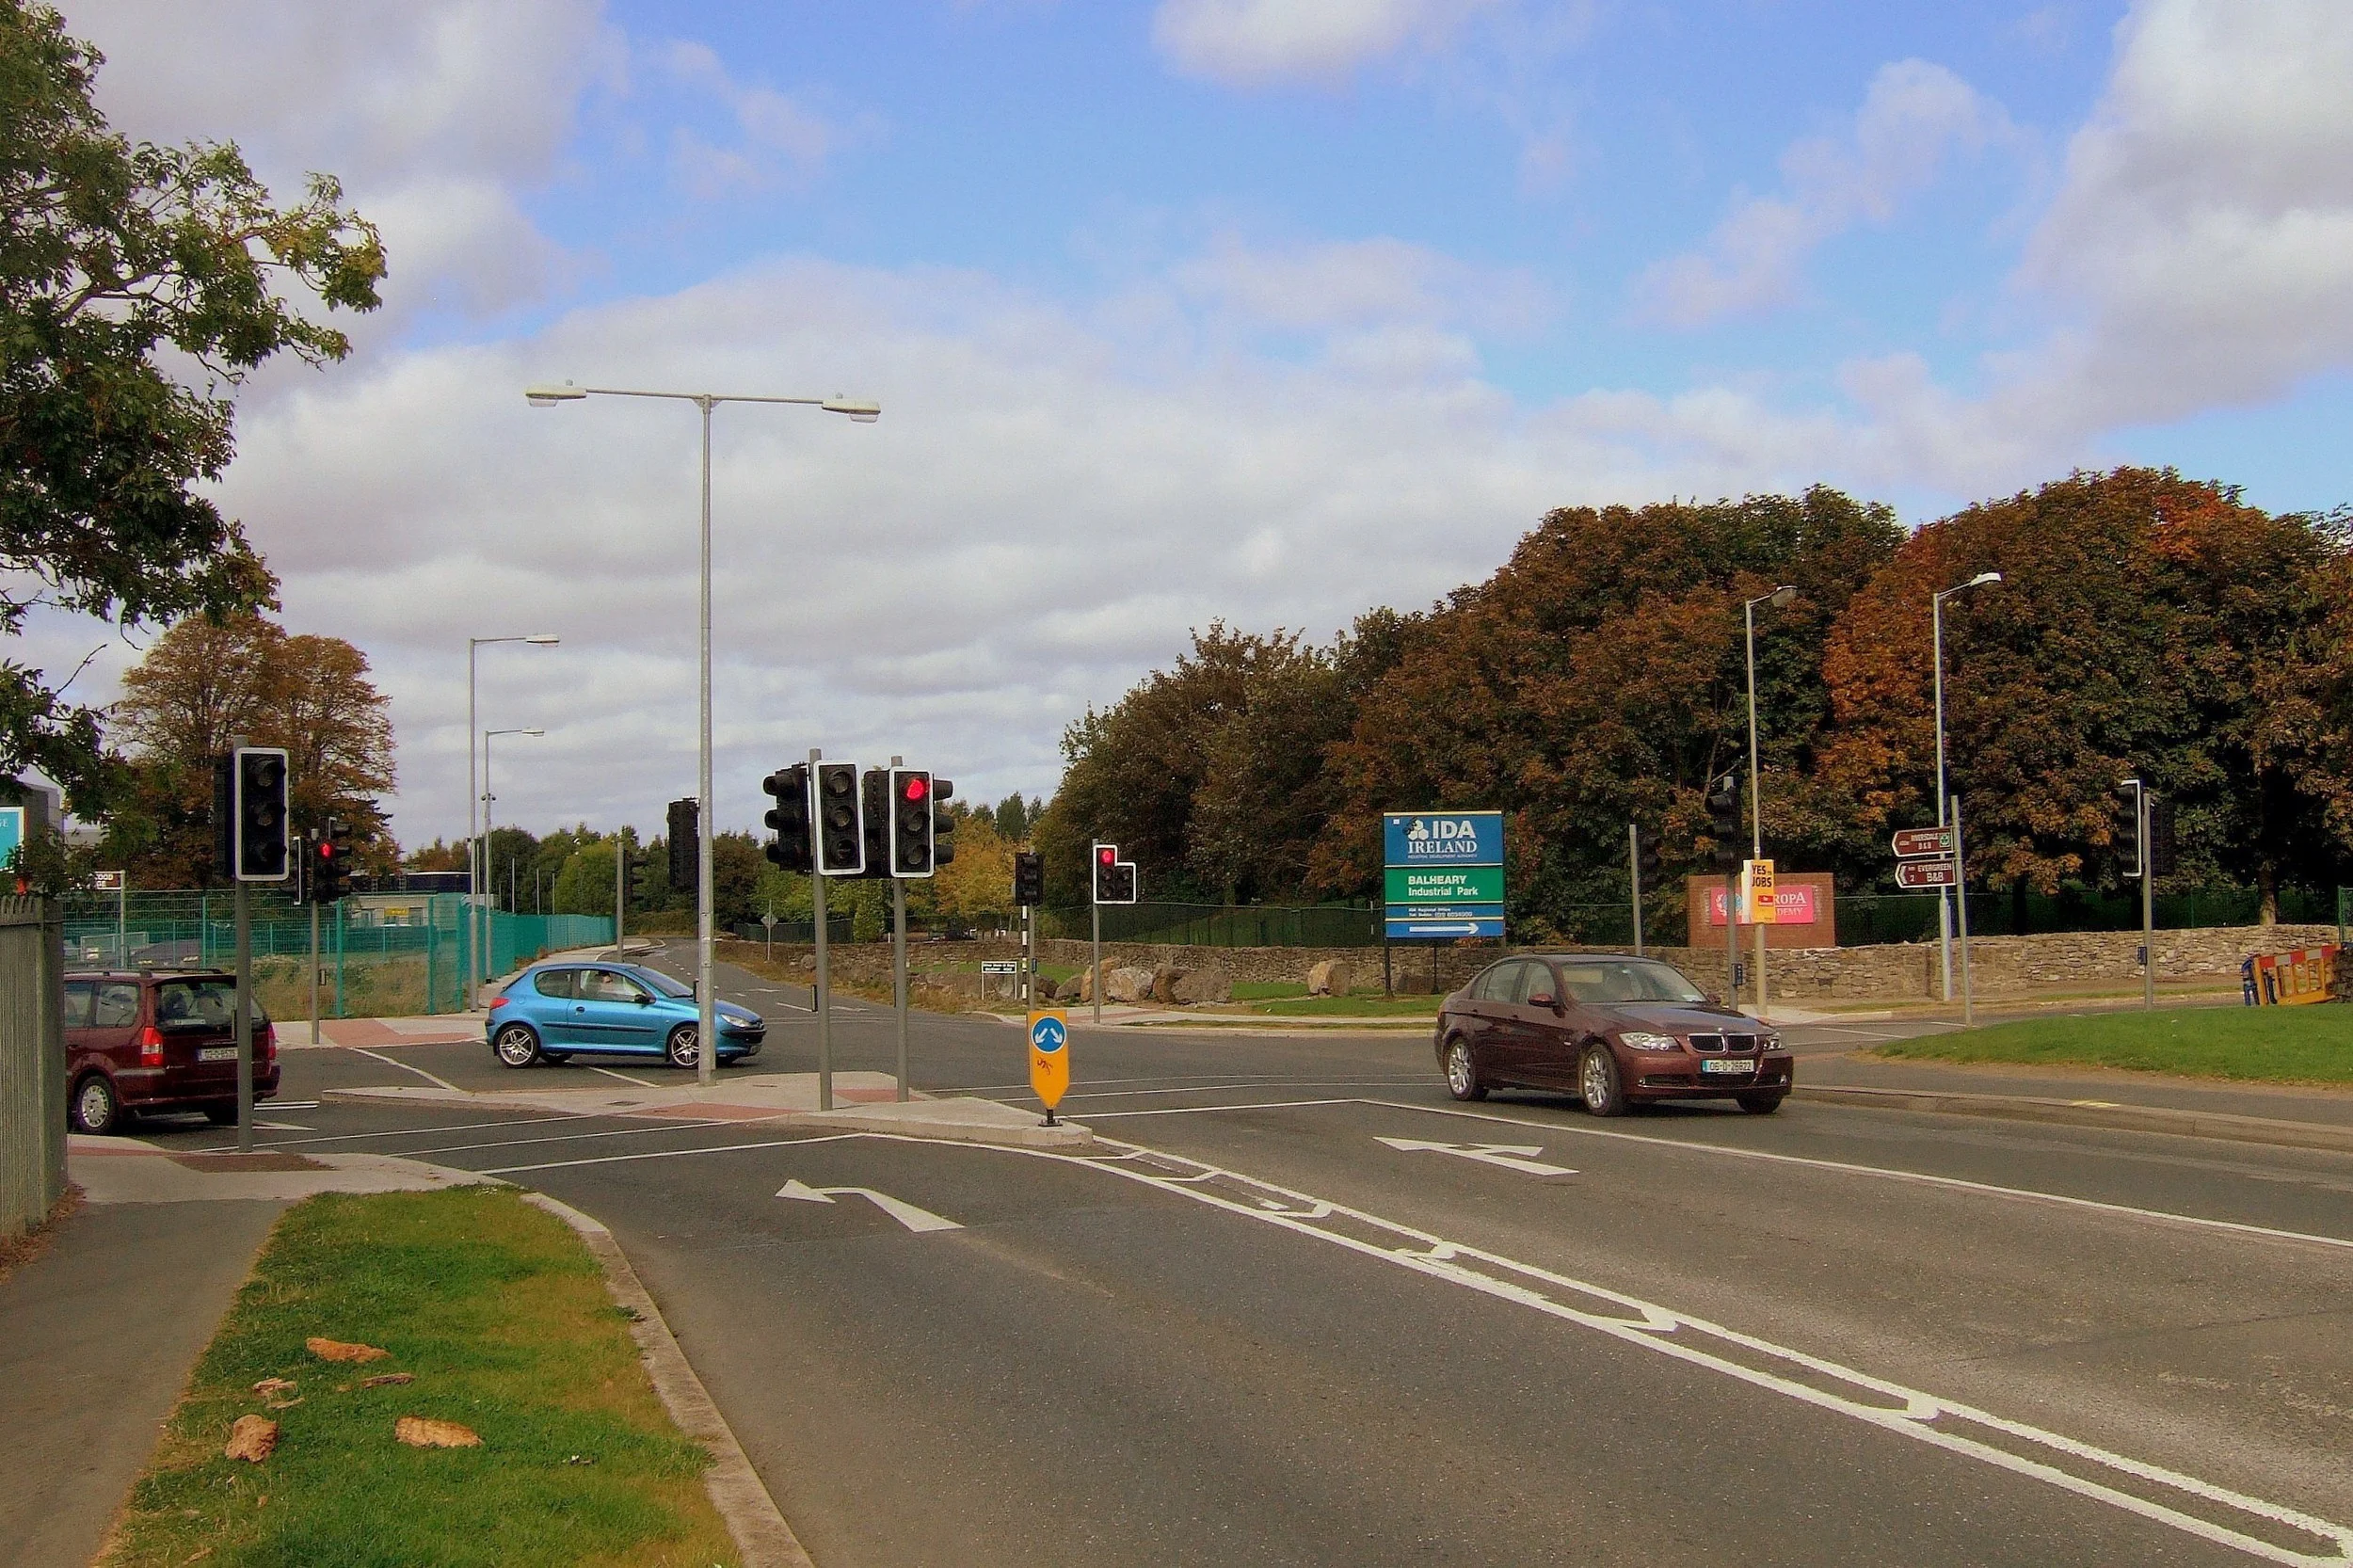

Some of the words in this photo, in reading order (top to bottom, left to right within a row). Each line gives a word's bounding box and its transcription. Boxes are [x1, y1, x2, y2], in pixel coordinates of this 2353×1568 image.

[1432, 820, 1477, 840] IDA
[1407, 840, 1478, 854] IRELAND
[1752, 864, 1767, 875] YES
[1917, 863, 1952, 872] EVERGREEN
[1408, 874, 1467, 885] BALHEARY
[1752, 876, 1772, 888] JOBS
[1926, 872, 1944, 882] B&B
[1408, 887, 1451, 896] Industrial
[1457, 886, 1479, 896] Park
[1774, 891, 1807, 904] ROPA
[1776, 907, 1803, 916] DEMY
